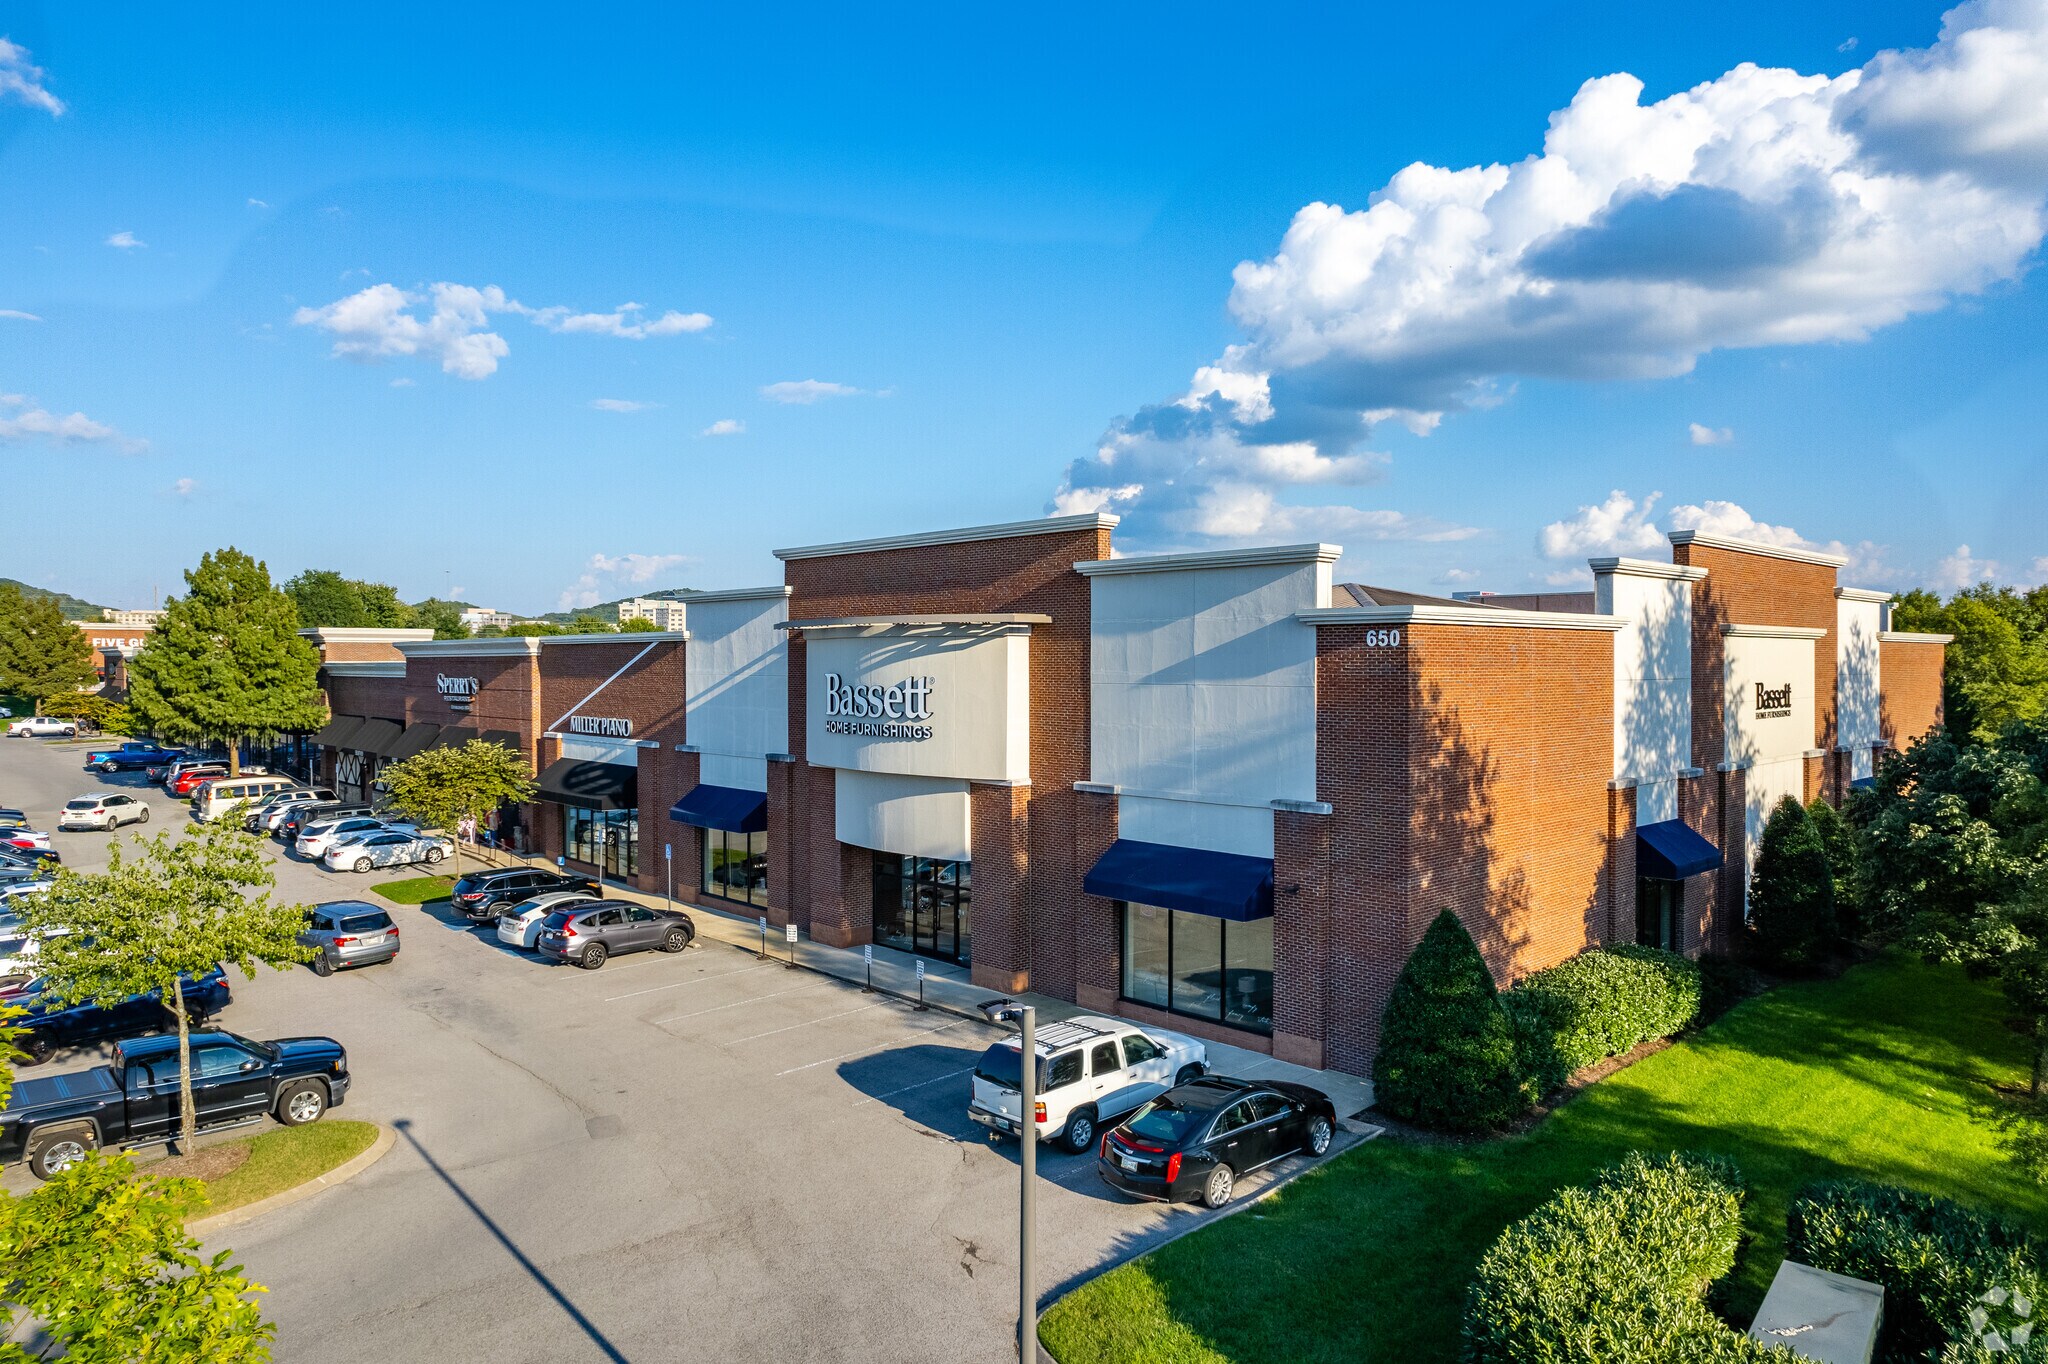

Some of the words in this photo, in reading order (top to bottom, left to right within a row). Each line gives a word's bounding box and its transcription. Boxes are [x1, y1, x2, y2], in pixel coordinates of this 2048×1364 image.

[92, 637, 126, 647] FIVE
[1366, 629, 1400, 647] 650
[825, 672, 934, 720] Bassett
[1755, 682, 1791, 710] Bassett
[570, 715, 600, 734] MILLER
[601, 717, 633, 737] PIANO
[826, 720, 849, 734] HOME
[851, 722, 933, 739] FURNISHINGS
